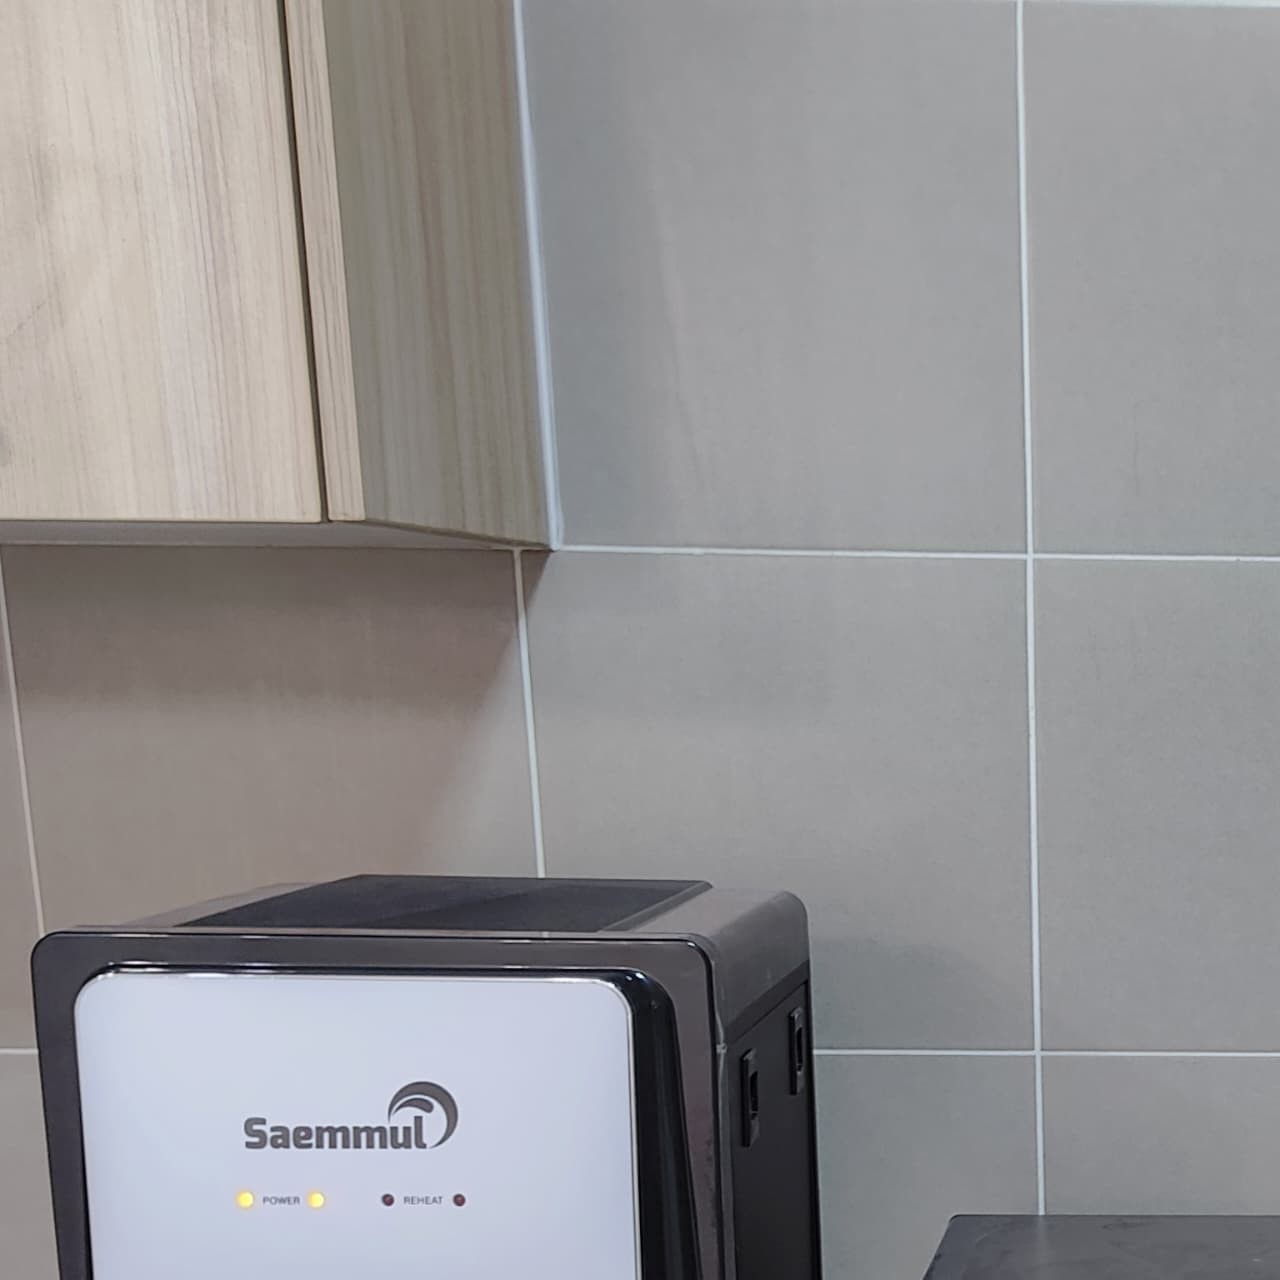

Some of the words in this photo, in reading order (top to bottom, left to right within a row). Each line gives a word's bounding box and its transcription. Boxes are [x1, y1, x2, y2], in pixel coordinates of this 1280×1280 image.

[244, 1116, 427, 1150] Saemmul
[262, 1196, 300, 1206] POWER
[403, 1196, 443, 1206] REHEAT
